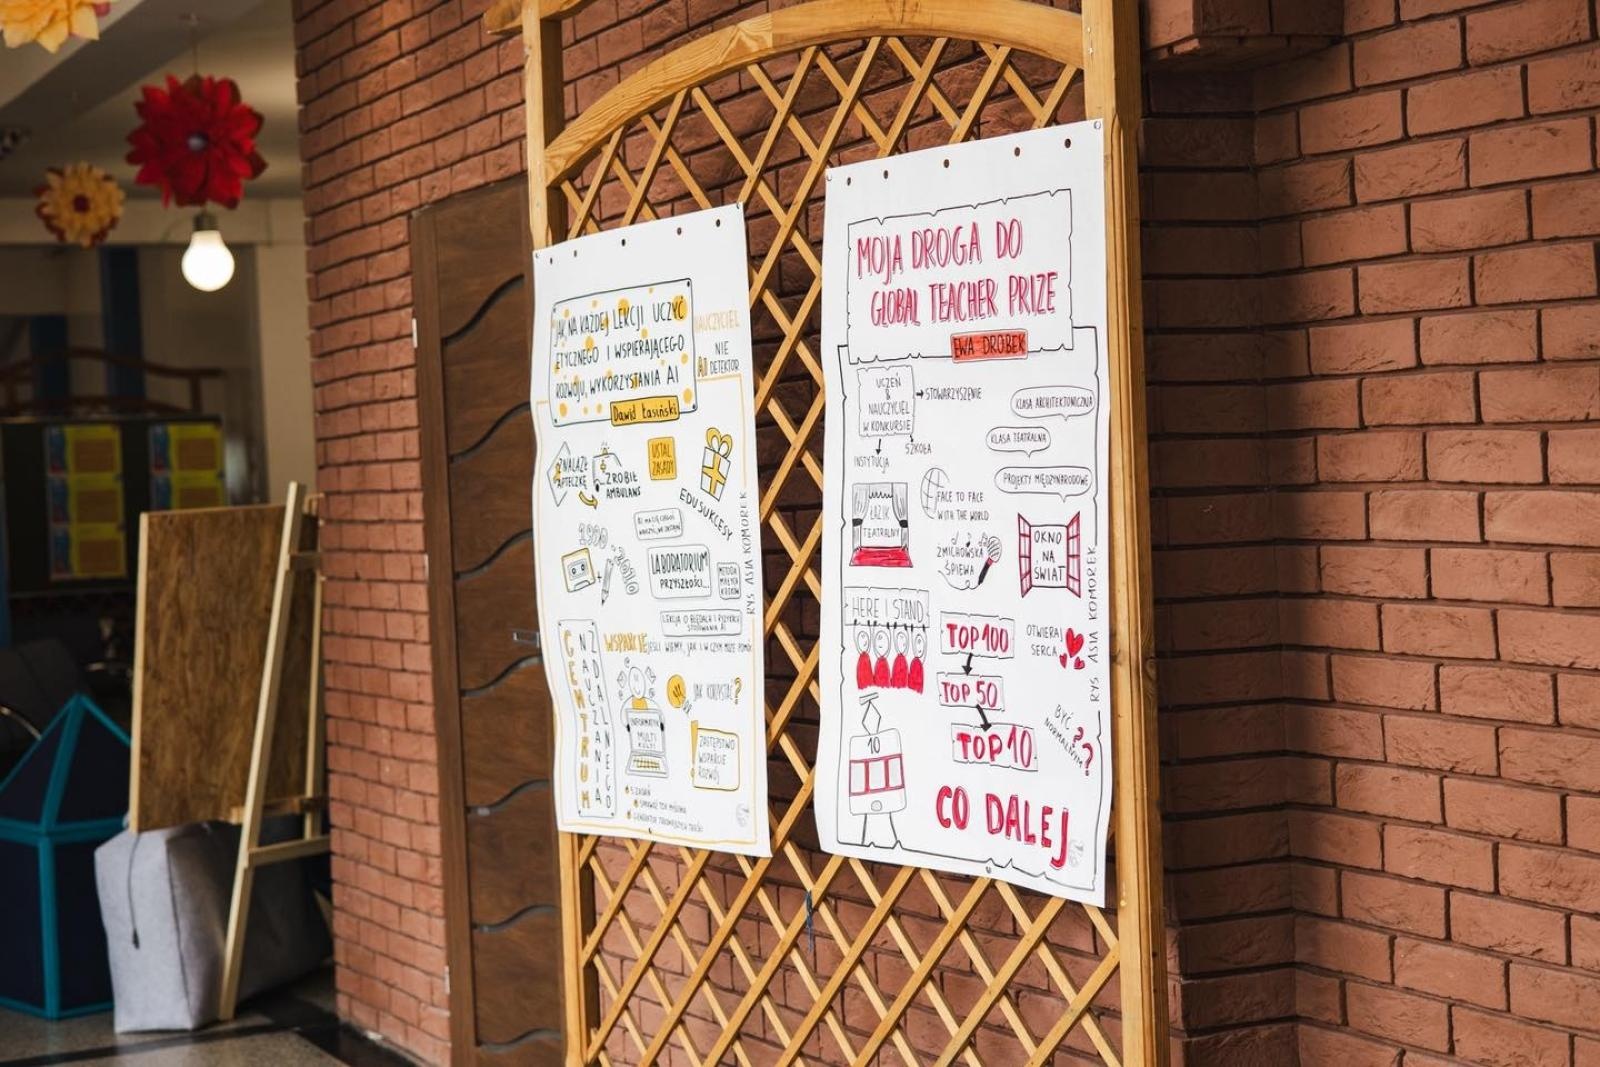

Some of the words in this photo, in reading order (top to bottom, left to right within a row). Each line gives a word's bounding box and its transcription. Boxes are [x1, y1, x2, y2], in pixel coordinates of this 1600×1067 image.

[857, 233, 904, 285] MOJA
[912, 222, 983, 270] DROGA
[996, 218, 1024, 259] DO
[871, 287, 921, 327] GLOBAL
[929, 278, 998, 324] TEACHER
[1009, 272, 1058, 317] PRIZE
[566, 317, 578, 337] NA
[580, 309, 610, 337] KAŻDEJ
[613, 304, 644, 331] LEKCJI
[652, 296, 685, 321] UCZYĆ
[555, 346, 599, 370] ETYCZNEGO
[614, 334, 685, 361] WSPIERAJĄCEGO
[715, 340, 729, 355] NIE
[953, 336, 975, 359] EWA
[983, 332, 1027, 355] DROBEK
[710, 359, 740, 374] DETEKTOR
[590, 370, 660, 394] WYKORZYSTANIA
[667, 365, 679, 385] AI
[925, 387, 982, 401] STOWARZYSZENIE
[613, 405, 637, 421] Dawid
[868, 400, 910, 415] NAUCZYCIEL
[1015, 398, 1033, 410] KLASA
[863, 422, 870, 431] W
[871, 420, 911, 431] KONKURSIE
[990, 433, 1011, 444] KLASA
[1013, 432, 1047, 443] TEATRALNA
[652, 443, 671, 458] USTAL
[854, 456, 889, 474] INSTYTUCJA
[1003, 473, 1031, 489] PROJEKTY
[606, 486, 641, 499] AMBULANS
[937, 491, 952, 502] FACE
[955, 491, 964, 501] TO
[968, 491, 983, 503] FACE
[740, 491, 752, 554] KOMOREK
[937, 510, 954, 520] WITH
[957, 510, 967, 520] THE
[970, 510, 989, 521] WORLD
[863, 527, 899, 538] TEATRALNY
[1034, 530, 1062, 544] OKNO
[651, 551, 708, 575] LABORATORIUM
[1042, 550, 1055, 563] NA
[744, 560, 755, 585] ASIA
[1086, 546, 1098, 620] KOMOREK
[852, 597, 879, 617] HERE
[893, 598, 924, 623] STAND
[946, 623, 979, 649] TOP
[1026, 624, 1063, 642] OTWIERAJ
[1031, 644, 1058, 657] SERCA
[1088, 631, 1099, 663] ASIA
[941, 681, 970, 703] TOP
[976, 680, 998, 708] 50
[1090, 677, 1101, 702] RYS
[867, 736, 881, 754] 10
[956, 732, 1003, 762] TOP
[1007, 724, 1033, 768] 10
[936, 786, 970, 830] CO
[985, 792, 1069, 870] DALEJ
